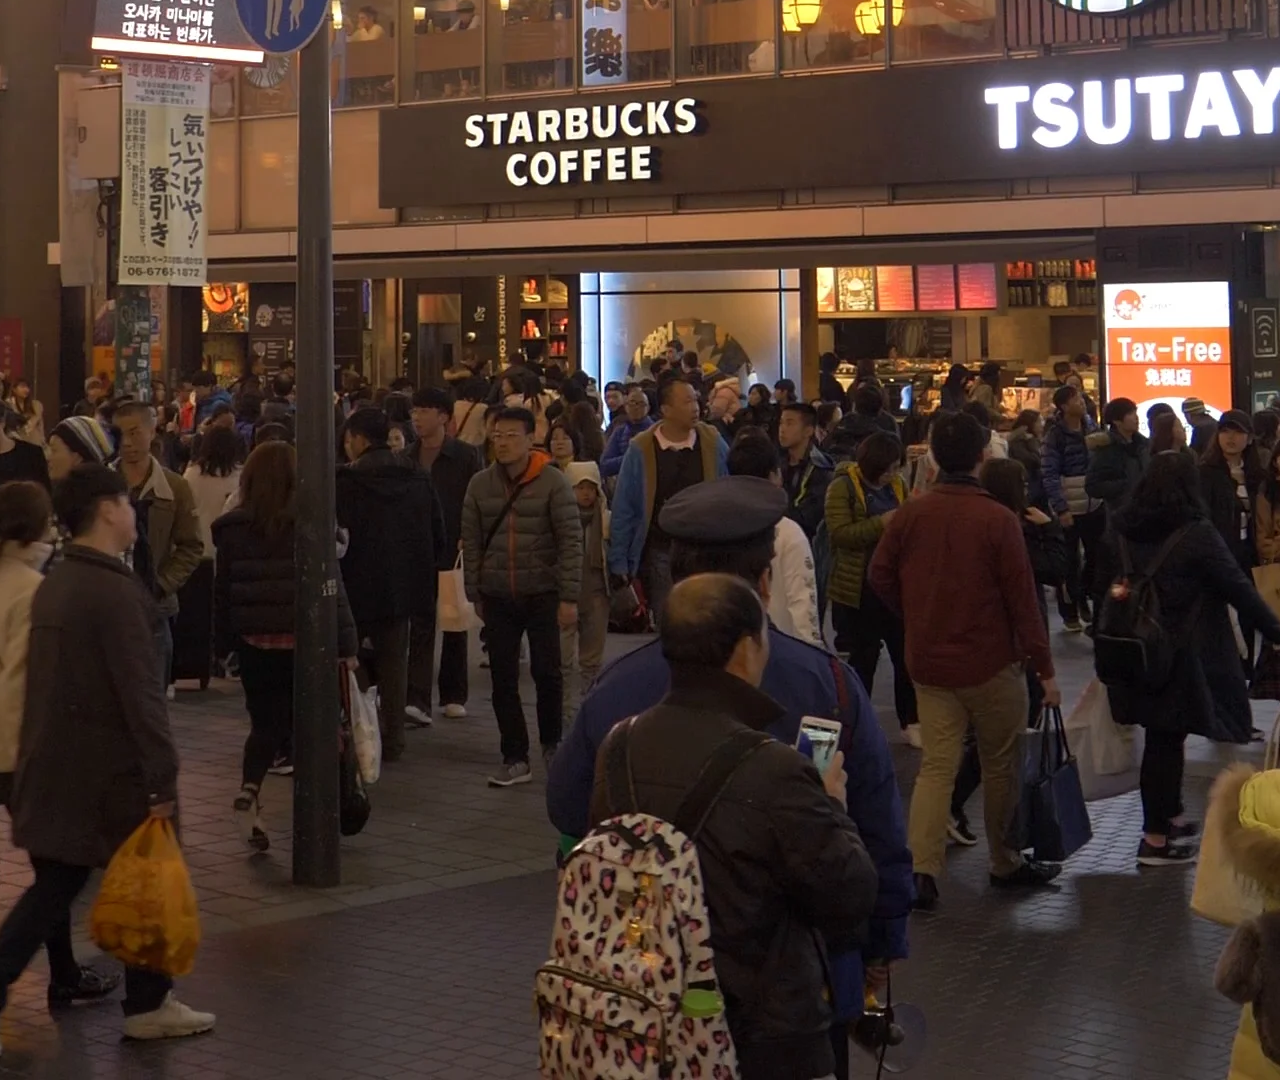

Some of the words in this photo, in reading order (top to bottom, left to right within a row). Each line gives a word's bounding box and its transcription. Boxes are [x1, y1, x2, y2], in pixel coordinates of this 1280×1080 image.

[123, 2, 162, 23] 오사카
[121, 21, 172, 41] 대표하는
[465, 98, 698, 149] STARBUCKS
[505, 145, 652, 187] COFFEE
[148, 166, 170, 249] 客引き
[1117, 336, 1222, 363] Tax-Free
[1144, 368, 1191, 387] 免税店
